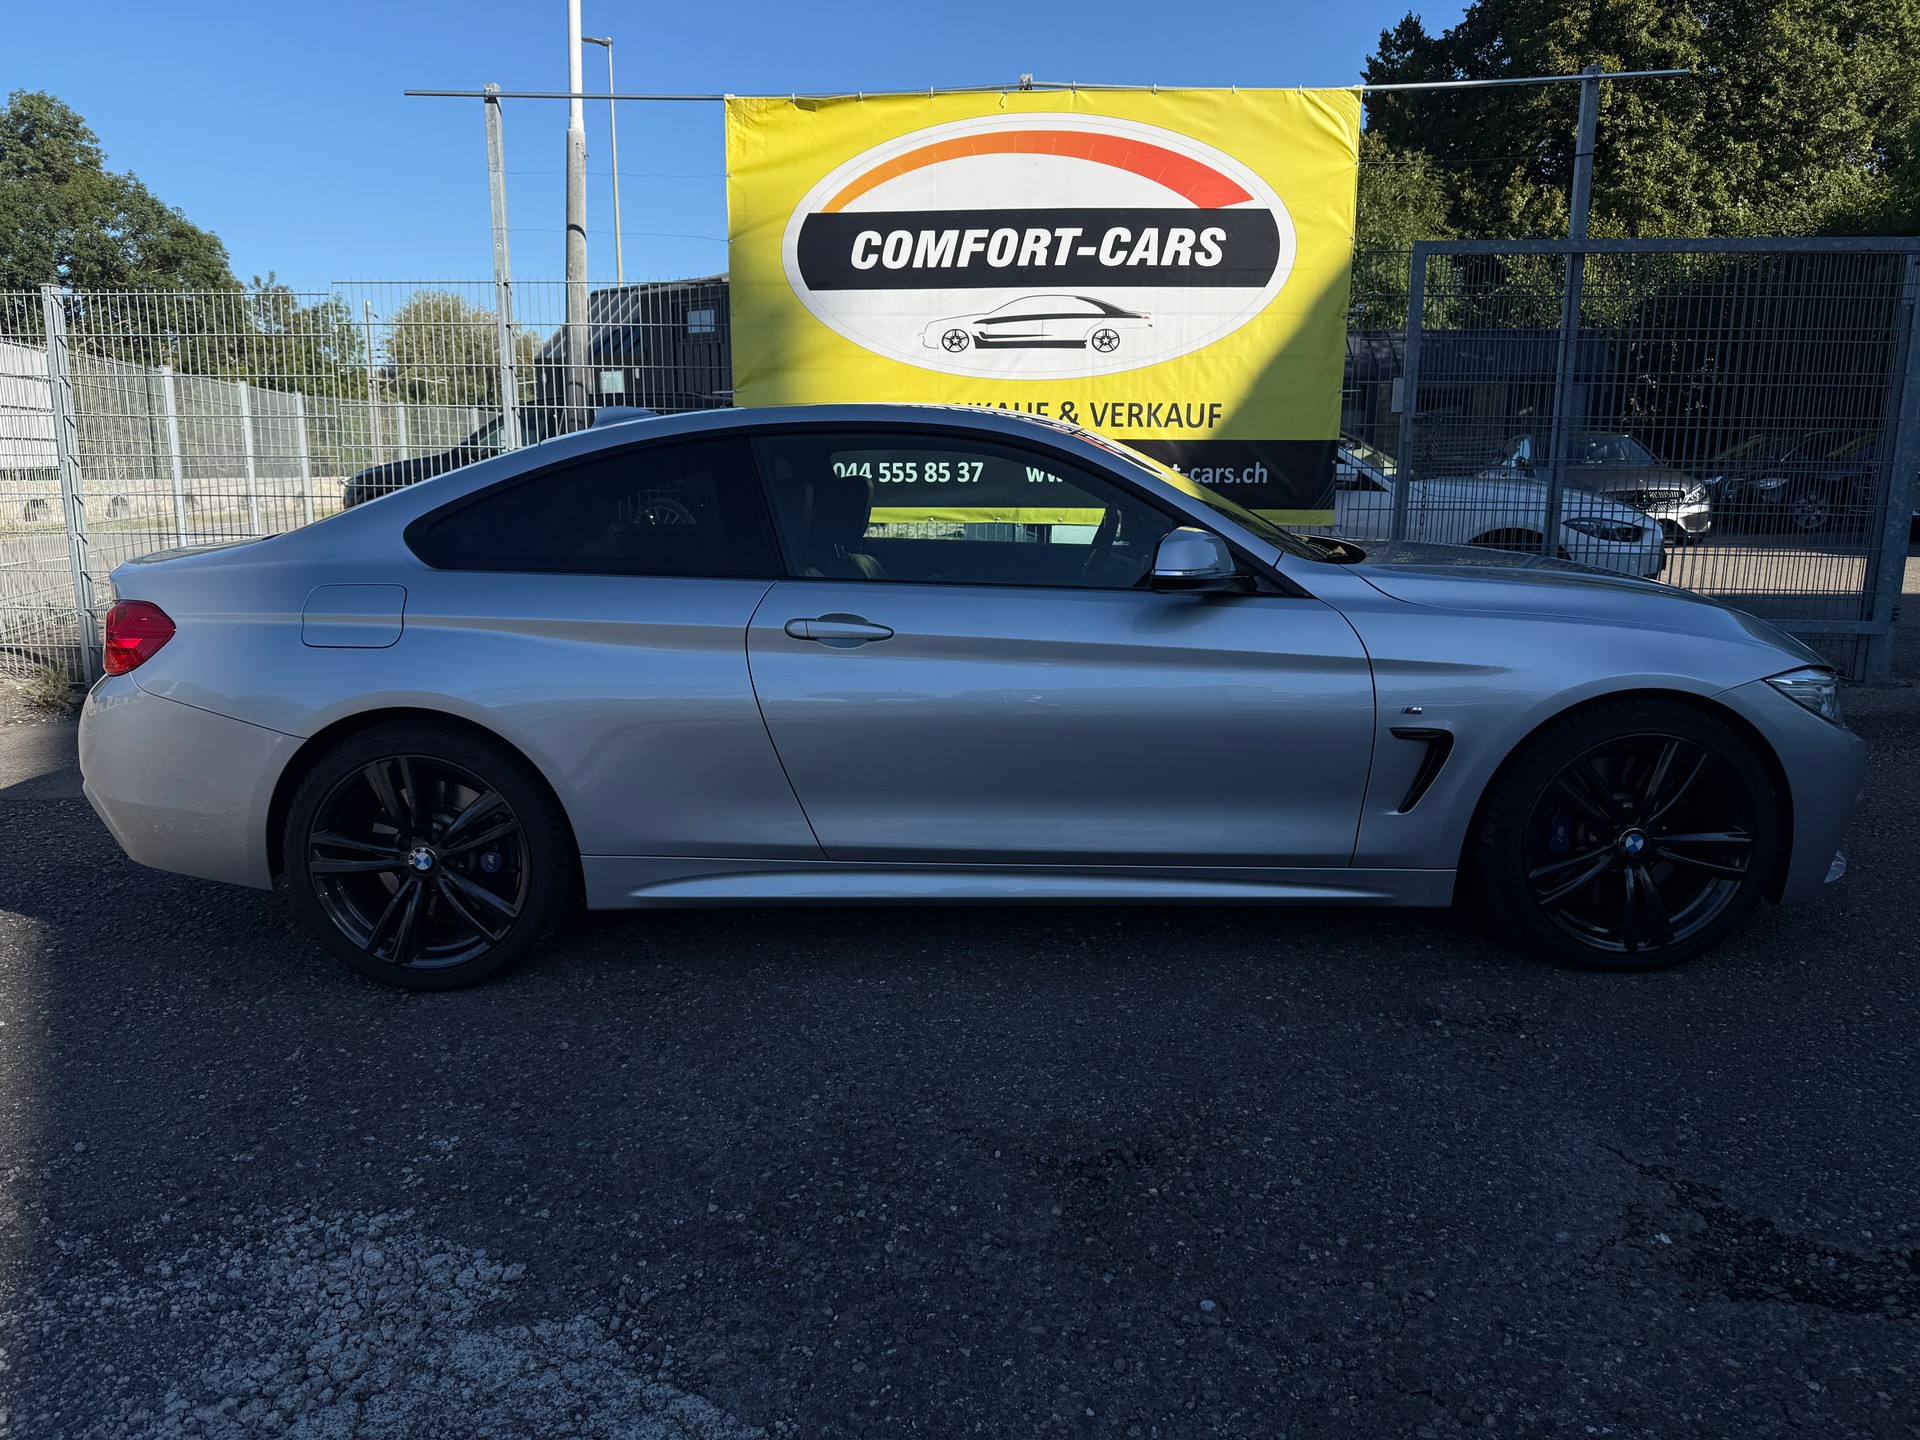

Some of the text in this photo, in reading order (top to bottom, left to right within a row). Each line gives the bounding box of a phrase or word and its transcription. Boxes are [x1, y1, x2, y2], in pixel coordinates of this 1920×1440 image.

[851, 227, 1227, 270] COMFORT-CARS
[1059, 401, 1080, 425] &
[1089, 402, 1222, 428] VERKAUF
[878, 463, 918, 483] 555
[924, 462, 950, 483] 85
[957, 462, 984, 483] 37
